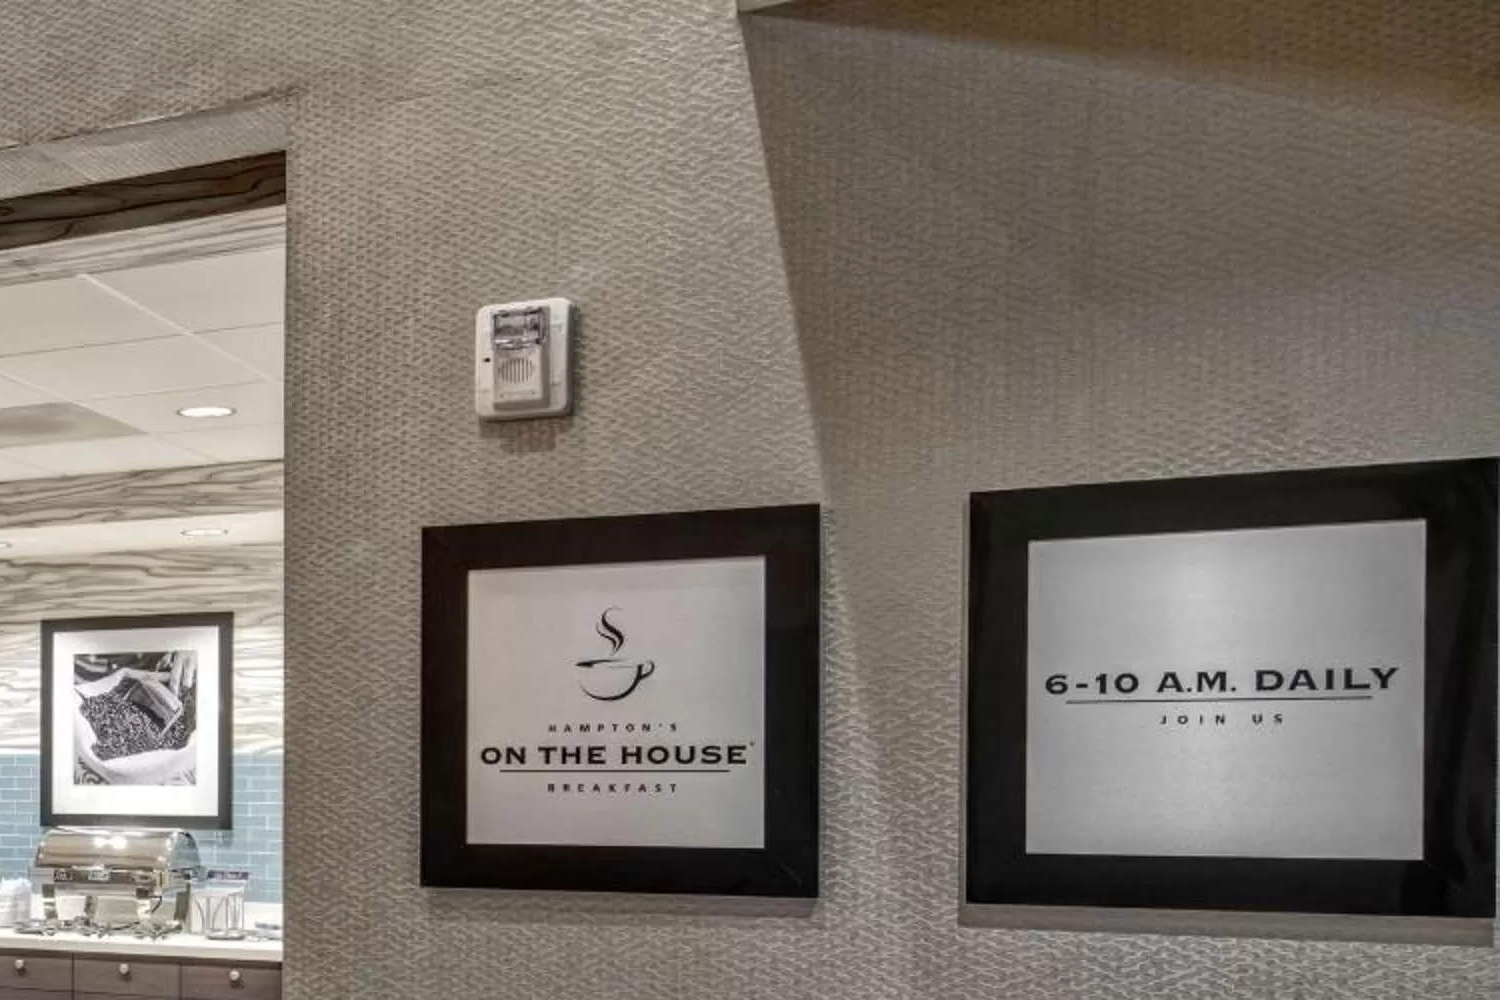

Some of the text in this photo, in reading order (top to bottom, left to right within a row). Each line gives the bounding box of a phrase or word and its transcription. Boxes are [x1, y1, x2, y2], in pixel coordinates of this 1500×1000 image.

[1045, 667, 1400, 695] 6-10 A.M. DAILY
[1161, 714, 1283, 724] JOIN US
[548, 723, 677, 733] HAMPTON'S
[480, 744, 748, 765] ON THE HOUSE
[547, 783, 677, 793] BREAKFAST
